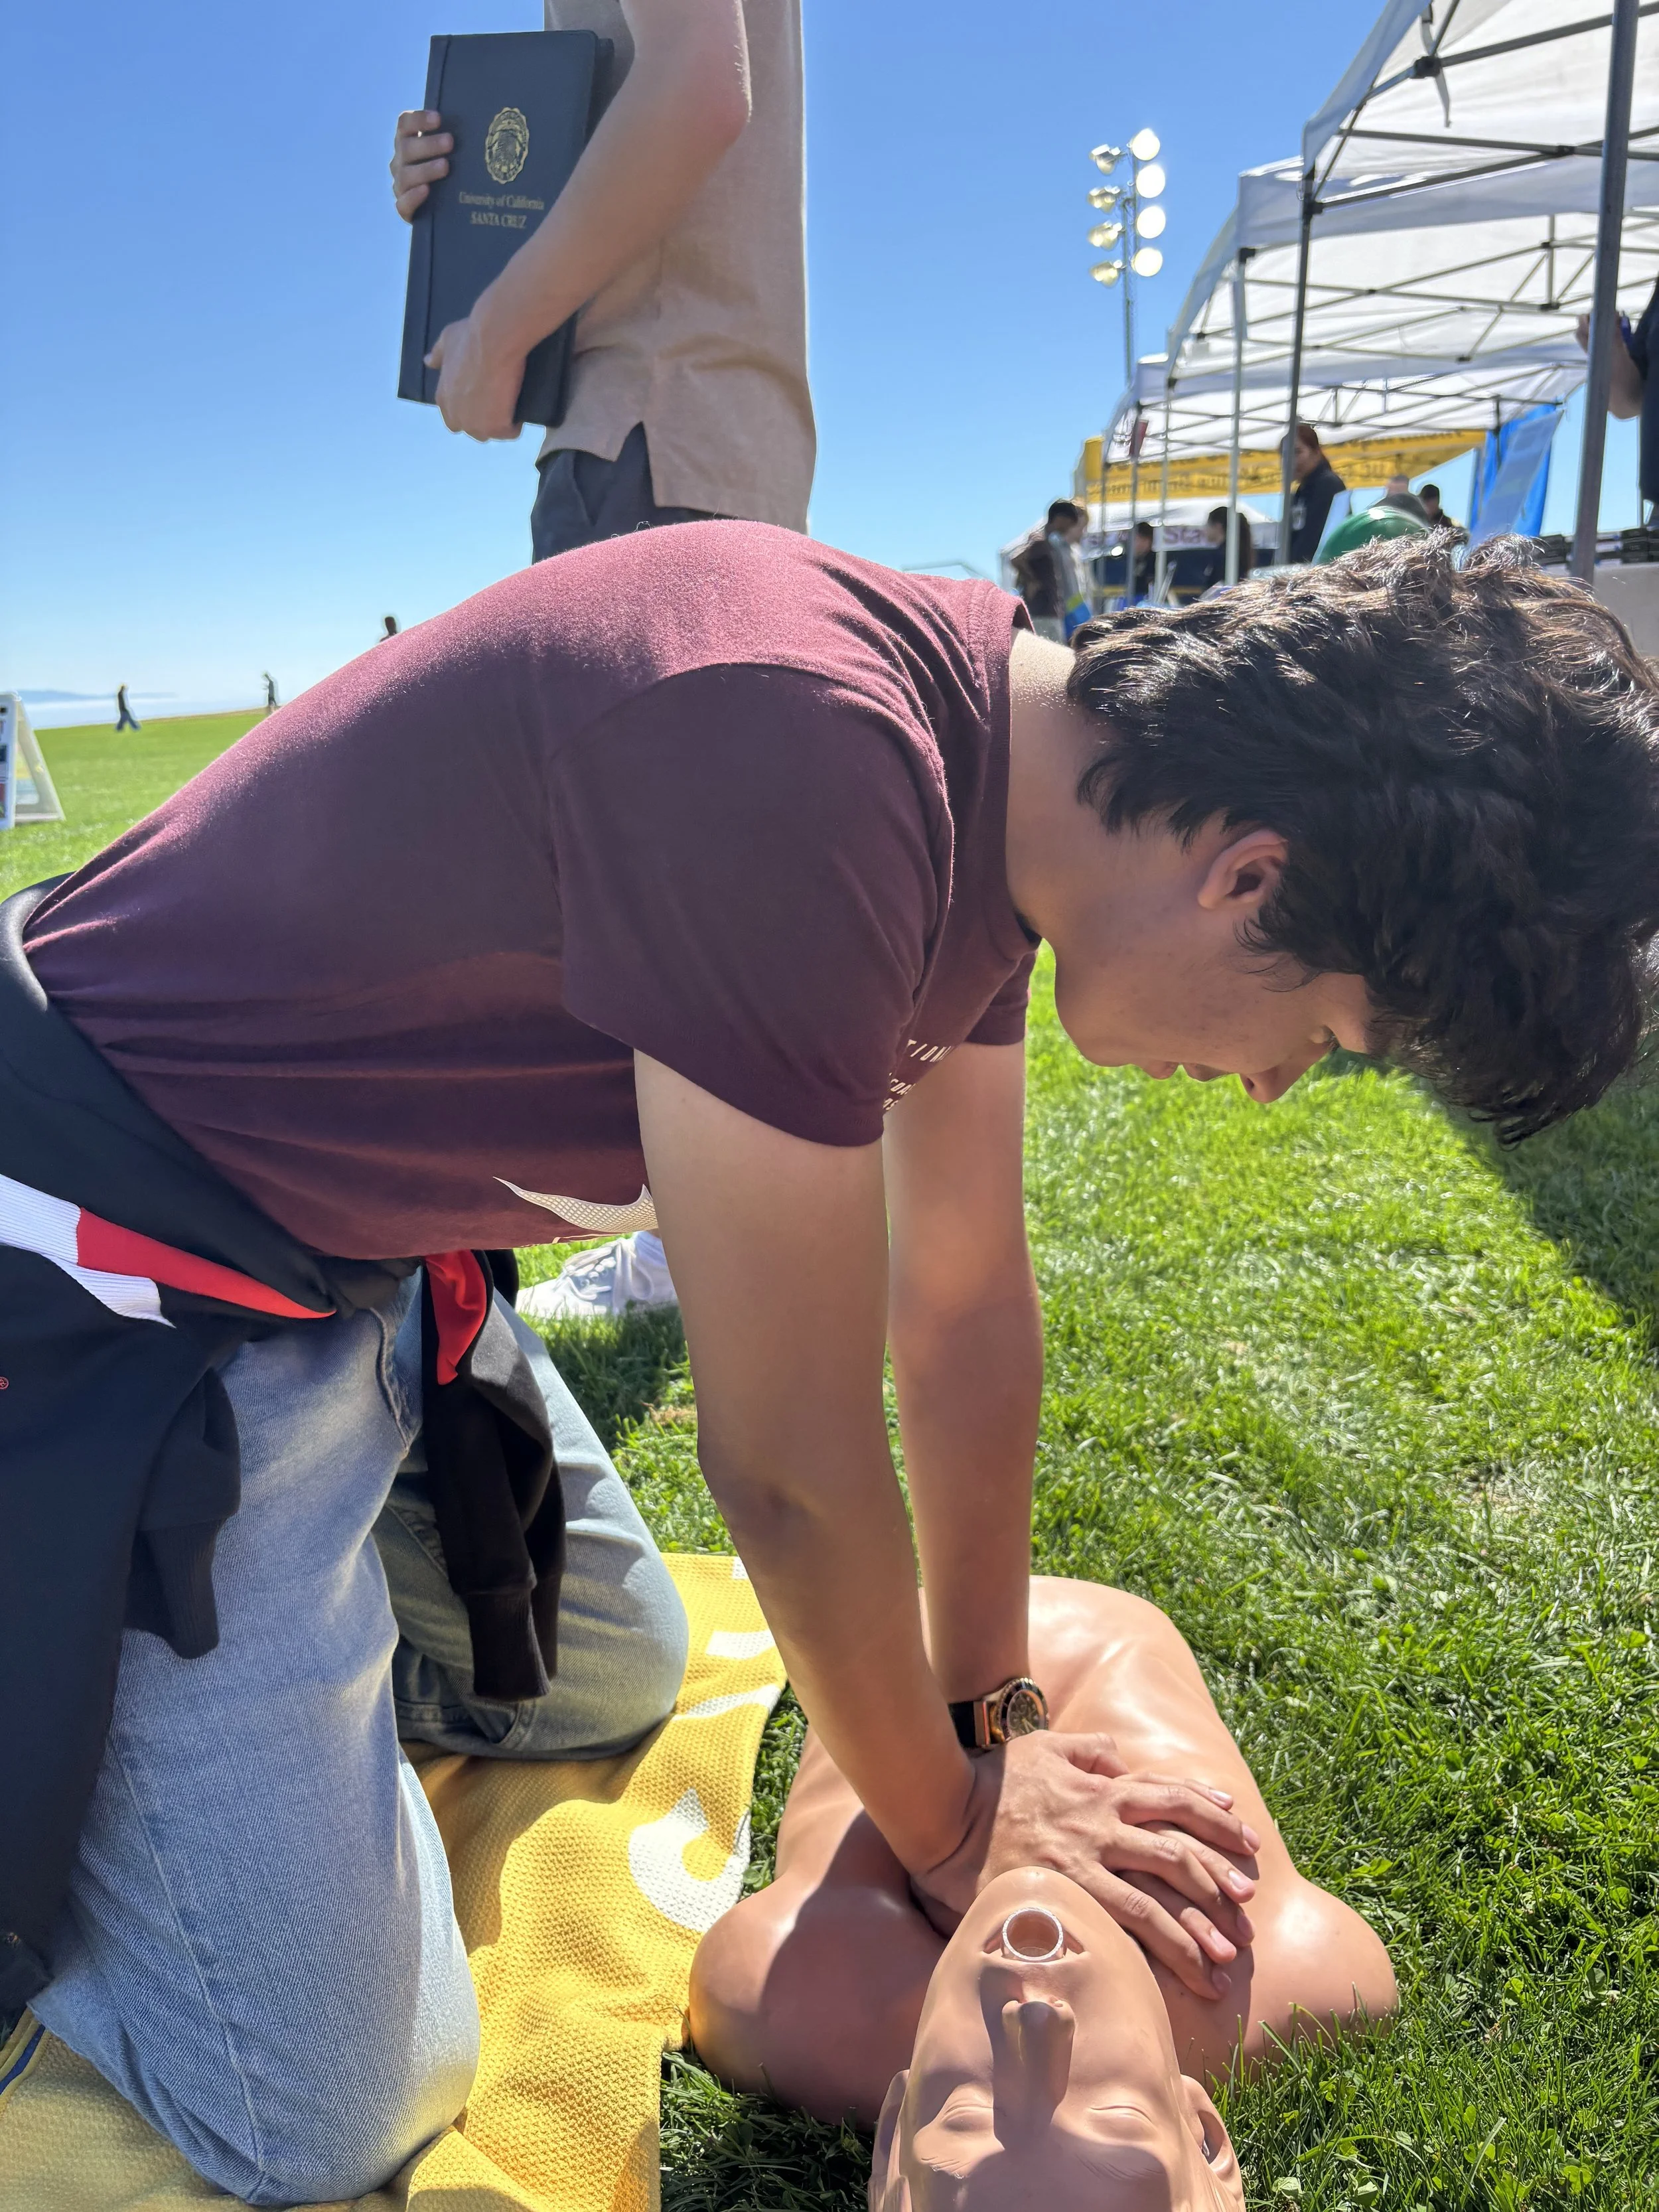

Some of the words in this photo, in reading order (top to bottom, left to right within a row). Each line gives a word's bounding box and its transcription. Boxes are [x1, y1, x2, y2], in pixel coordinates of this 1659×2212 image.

[459, 191, 494, 209] University
[496, 194, 506, 207] of
[506, 195, 545, 210] California
[470, 211, 500, 226] SANTA
[501, 214, 528, 229] CRUZ
